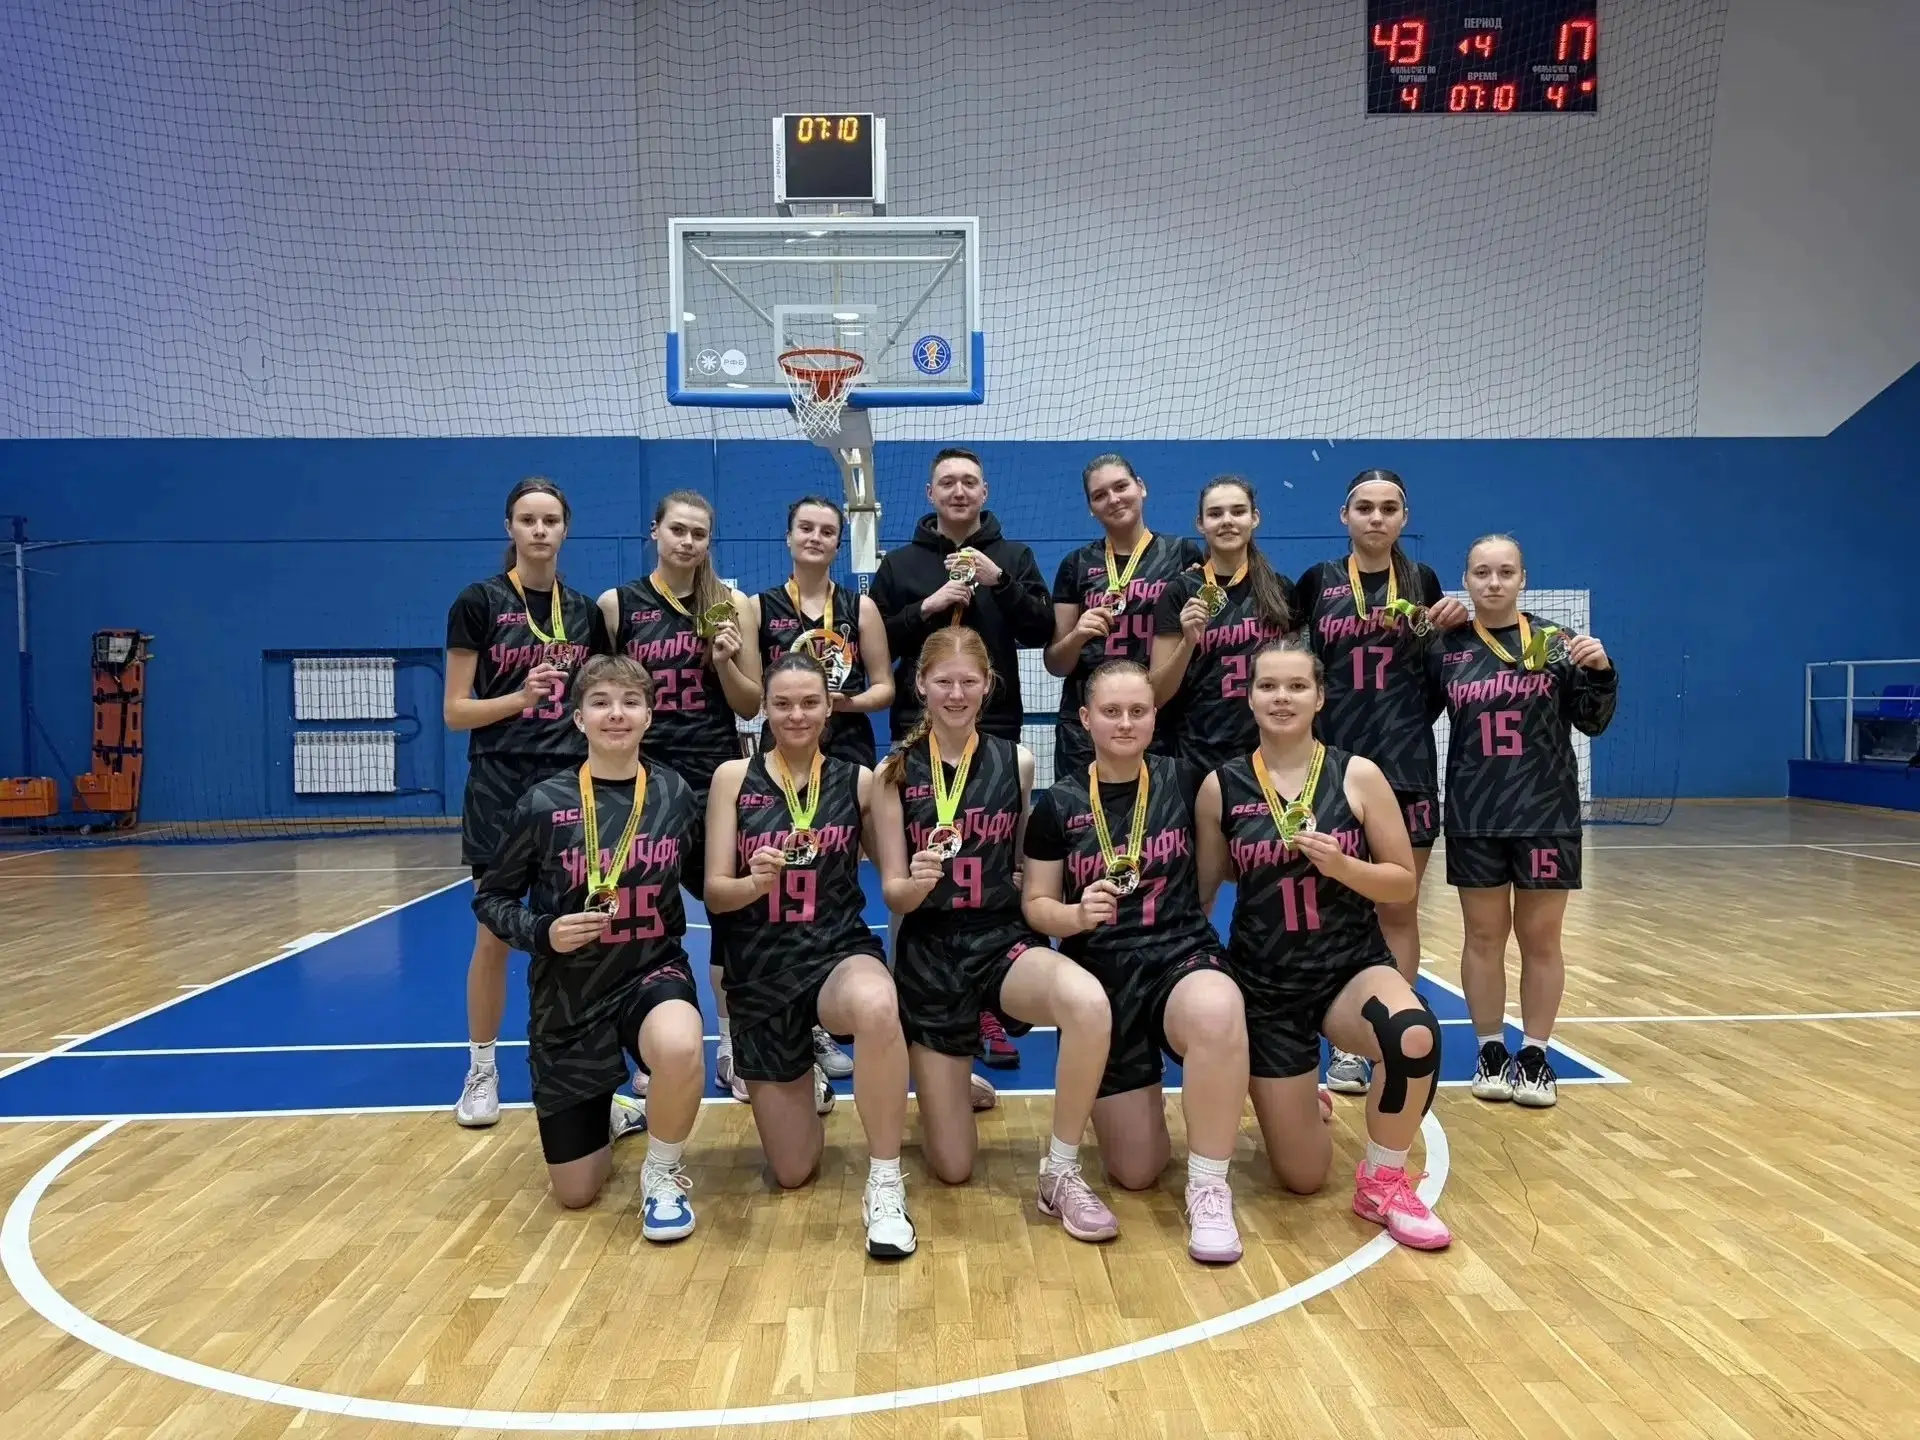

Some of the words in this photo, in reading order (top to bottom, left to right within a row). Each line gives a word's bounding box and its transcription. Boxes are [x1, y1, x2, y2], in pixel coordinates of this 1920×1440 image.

[1464, 17, 1502, 29] ПЕРИОД
[1374, 21, 1424, 63] 43
[1474, 35, 1491, 57] 4
[1467, 72, 1497, 80] ВРЕМЯ
[1402, 87, 1418, 109] 4
[1450, 85, 1514, 111] 07:10
[1547, 86, 1563, 109] 4
[799, 117, 858, 141] 07:10
[1104, 614, 1154, 655] 24
[1349, 645, 1394, 690] 17
[652, 668, 706, 710] 22
[1477, 710, 1523, 756] 15
[906, 785, 934, 798] АС
[552, 808, 583, 823] АС
[1405, 799, 1431, 832] 17
[1529, 848, 1559, 879] 15
[768, 869, 817, 922] 19
[952, 857, 982, 909] 9
[600, 884, 665, 943] 25
[1277, 876, 1320, 931] 11
